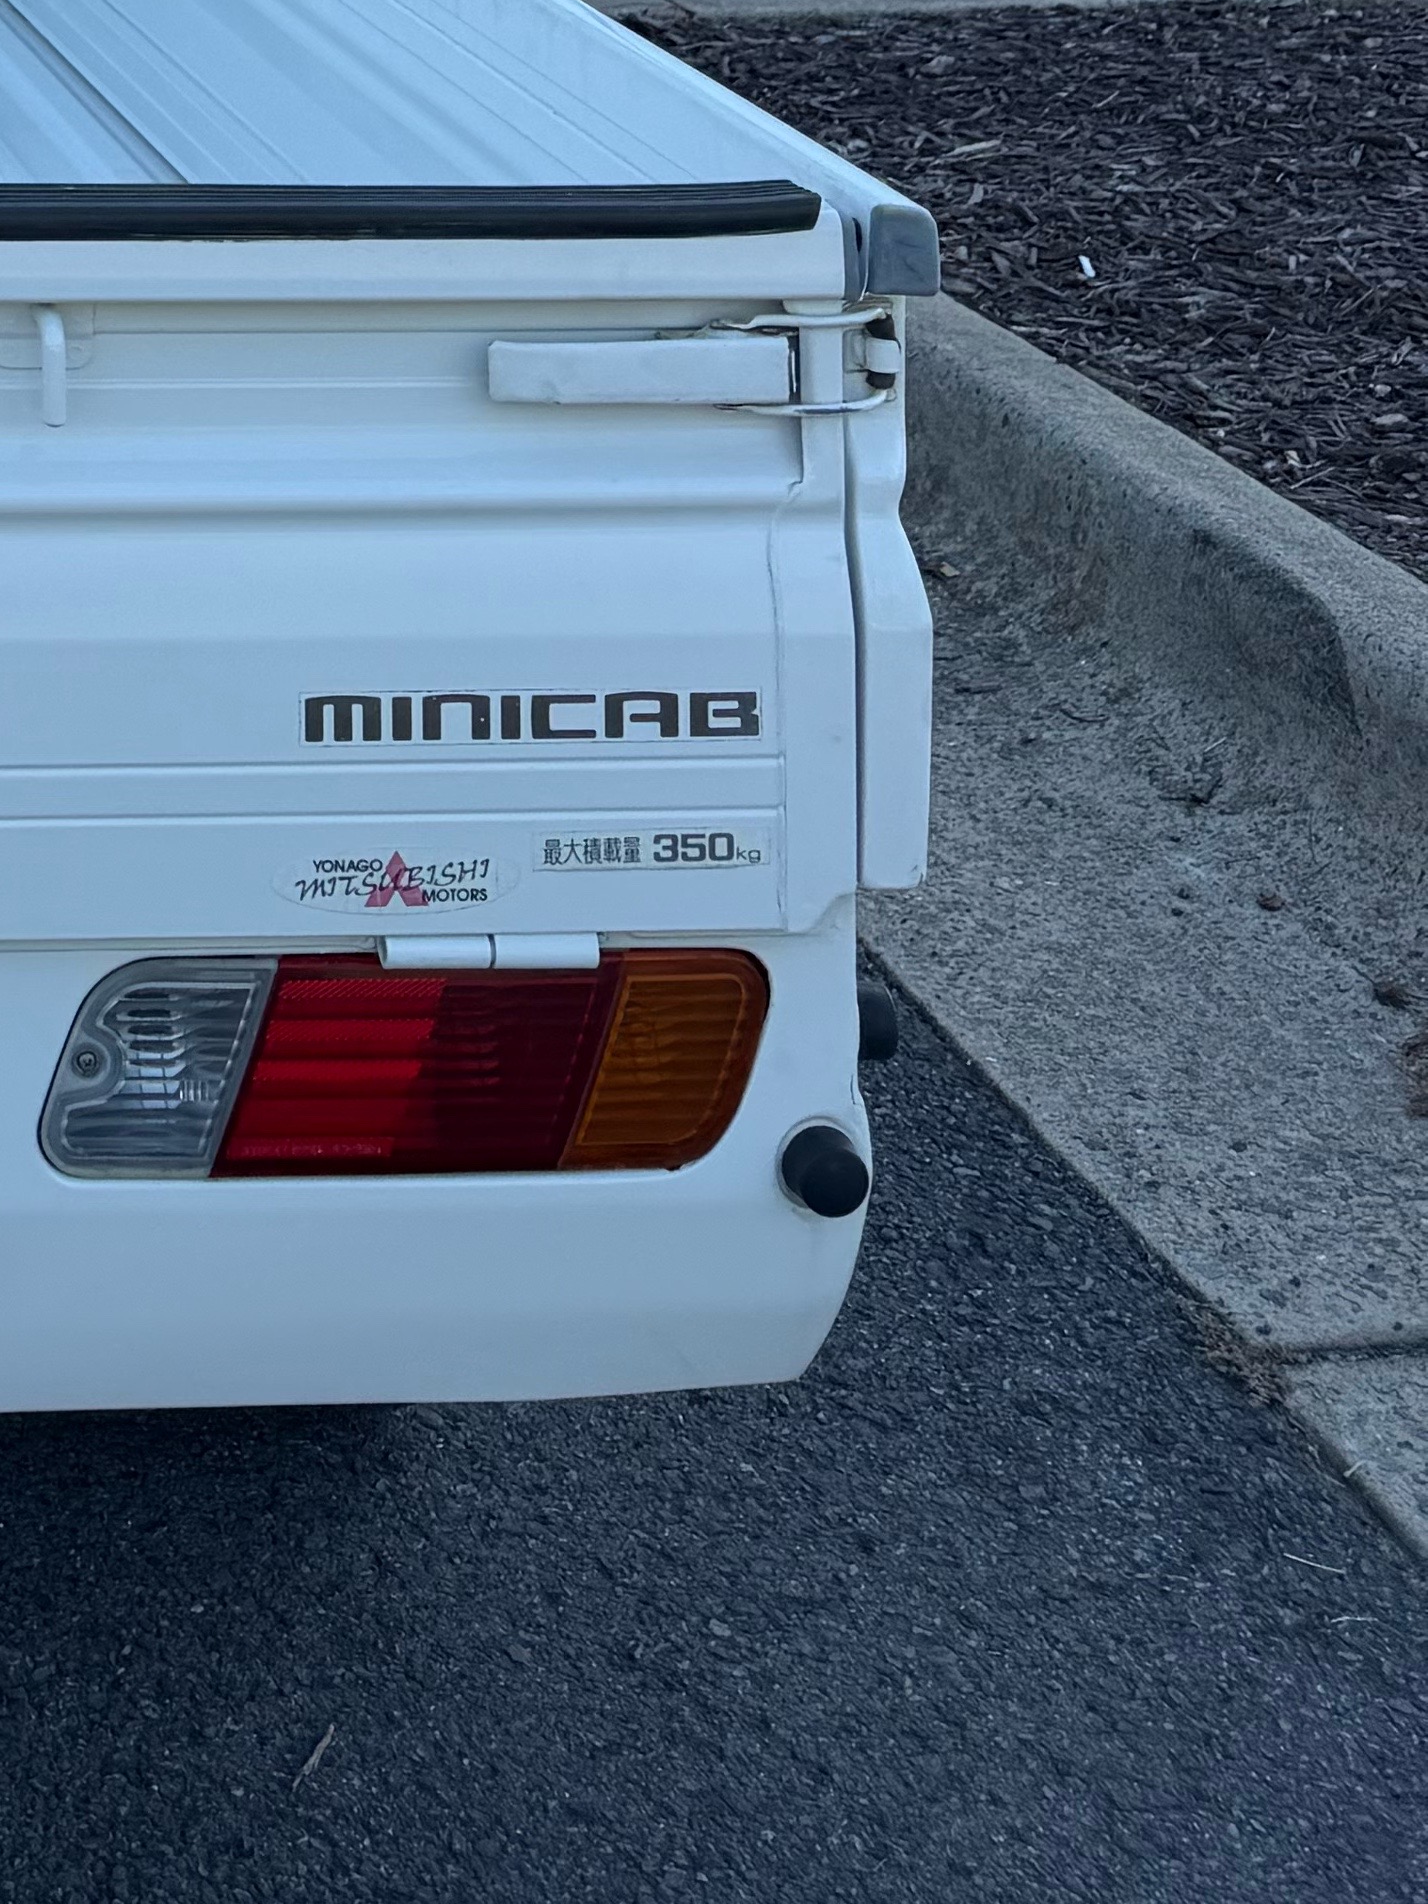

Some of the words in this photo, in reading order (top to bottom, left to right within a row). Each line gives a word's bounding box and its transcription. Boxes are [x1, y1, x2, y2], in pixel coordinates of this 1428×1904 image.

[304, 690, 760, 743] MINICAB
[312, 859, 384, 873] YONAGO
[542, 836, 642, 866] 最大積載量
[294, 858, 491, 902] MITSUBISHI
[421, 888, 489, 903] MOTORS
